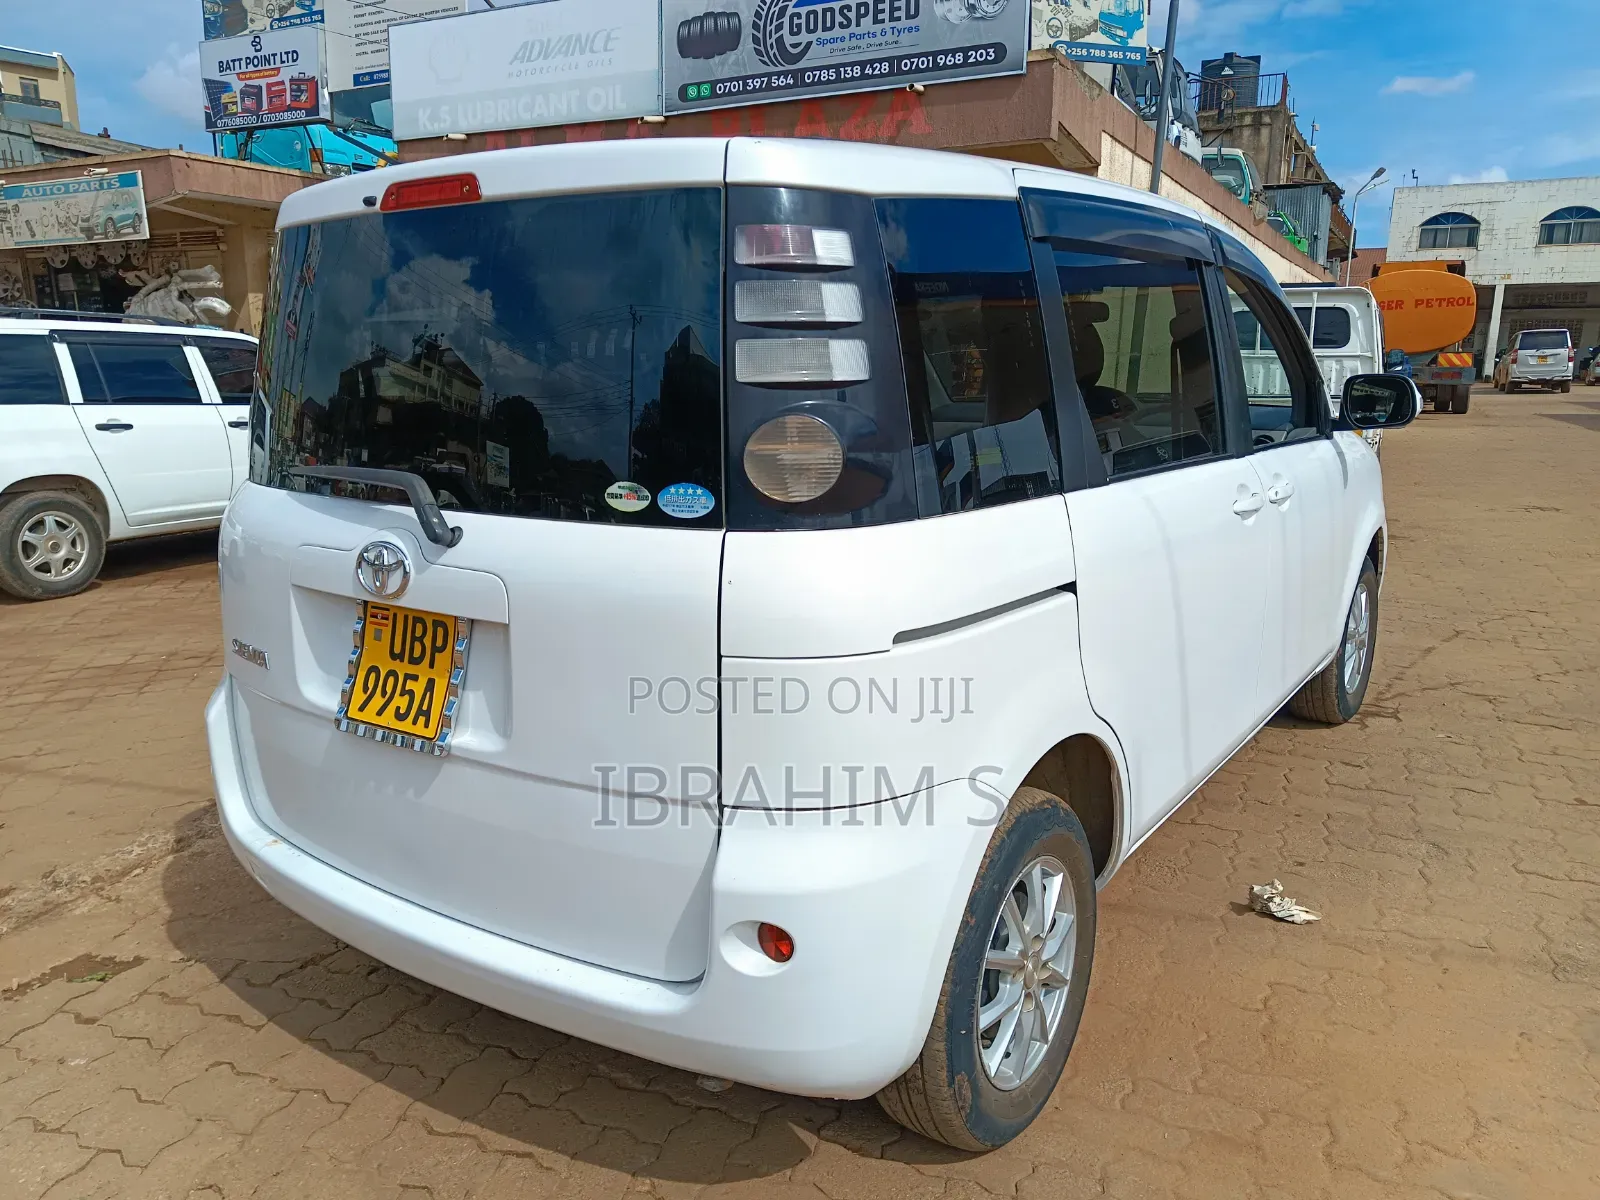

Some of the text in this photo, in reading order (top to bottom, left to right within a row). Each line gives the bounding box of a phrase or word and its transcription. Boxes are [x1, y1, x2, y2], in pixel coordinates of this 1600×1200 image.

[788, 0, 920, 36] GODSPEED
[508, 26, 622, 65] ADVANCE
[816, 25, 920, 47] Spare Parts & Tyres
[218, 50, 299, 73] BATT POINT LTD
[1067, 48, 1141, 60] +256 788 365 765
[508, 57, 613, 78] MOTORCYCLE OILS
[716, 48, 996, 94] 0701 397 564 0785 138 428 0701 968 203
[457, 89, 580, 127] LUBRICANT
[586, 85, 627, 113] OIL
[216, 115, 257, 127] 0776085000
[262, 110, 306, 122] 0703085000
[22, 178, 120, 198] AUTO PARTS
[1379, 296, 1475, 311] GER PETROL
[388, 611, 449, 670] UBP
[357, 664, 436, 729] 995A
